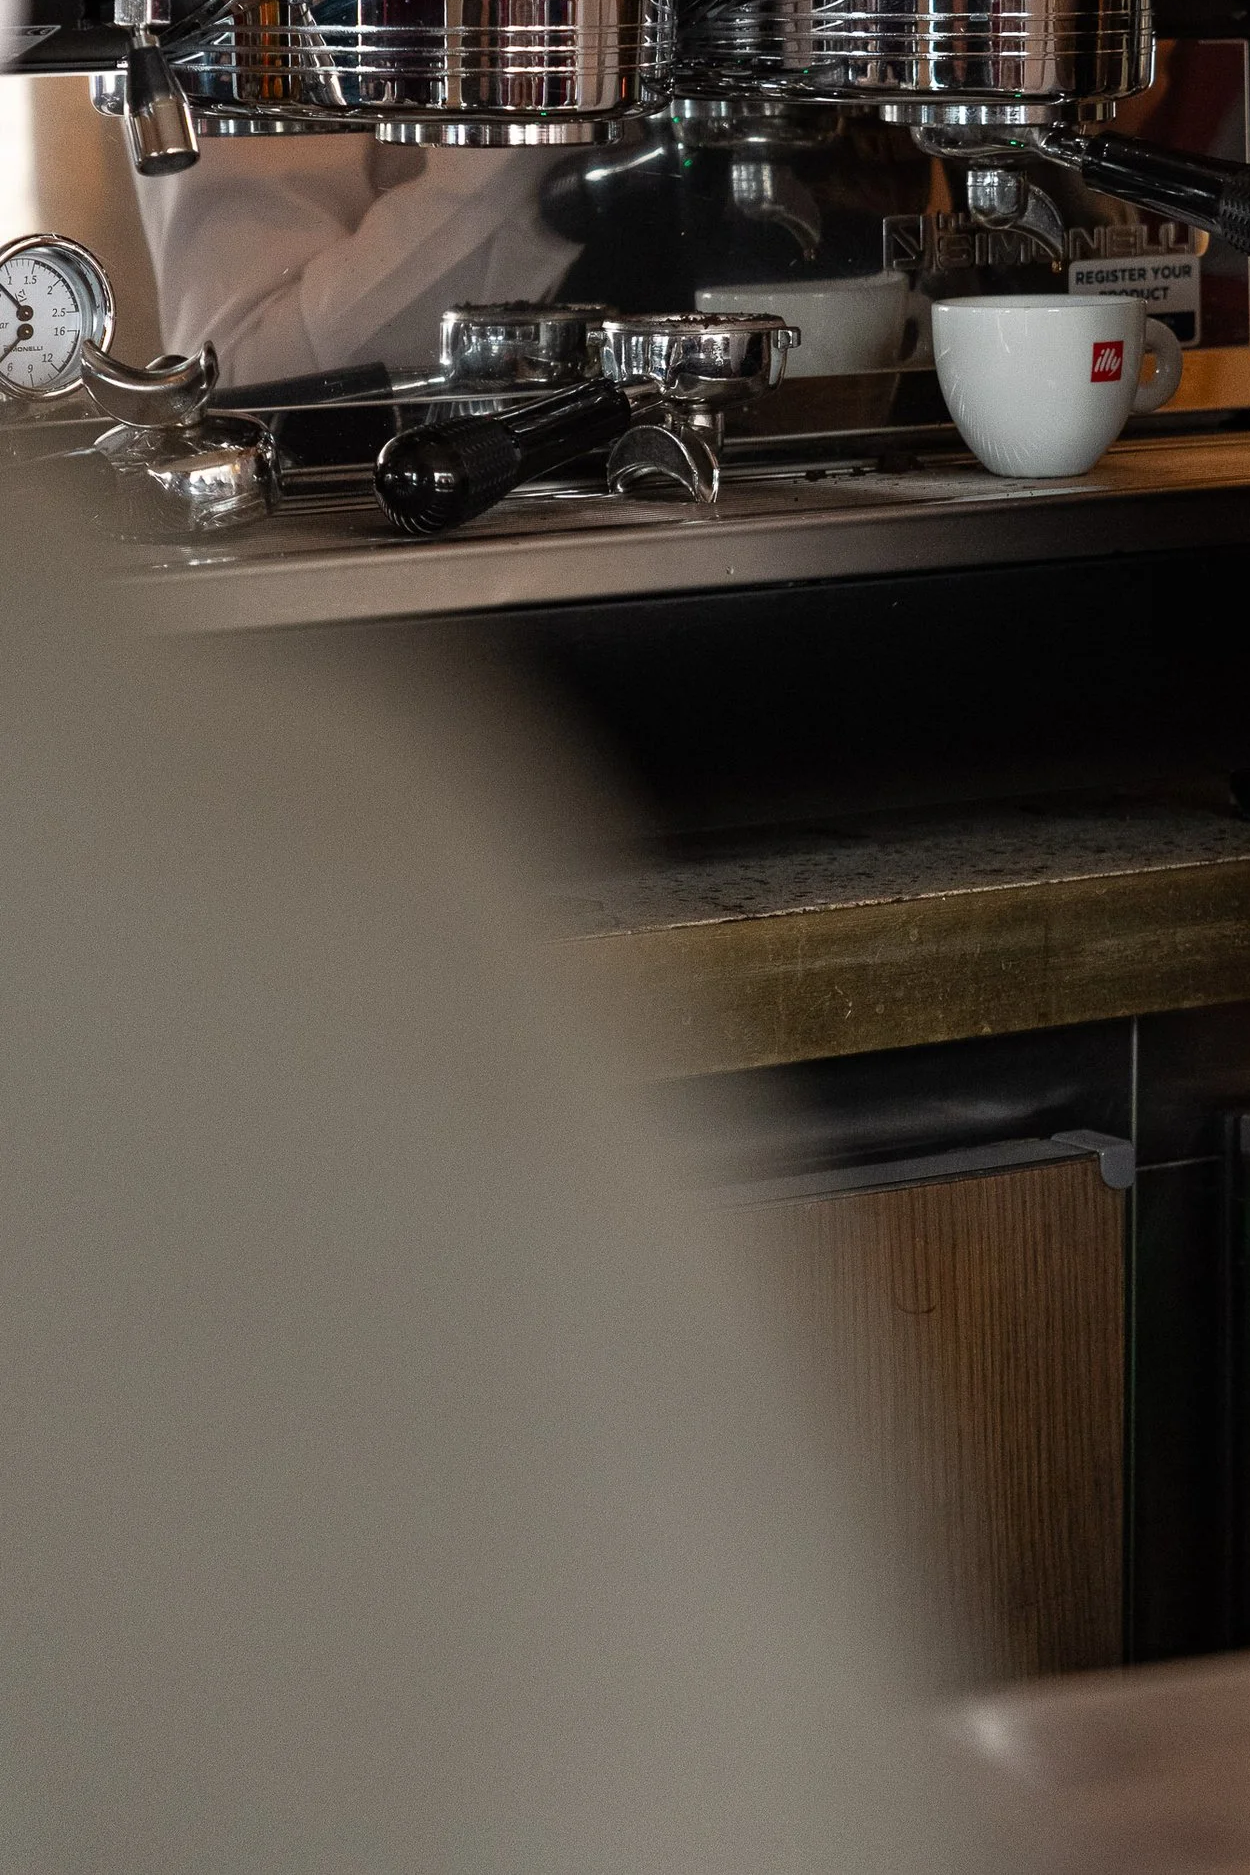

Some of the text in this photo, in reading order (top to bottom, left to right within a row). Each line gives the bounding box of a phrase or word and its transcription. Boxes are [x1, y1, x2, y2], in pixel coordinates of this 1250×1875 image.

[1076, 264, 1193, 285] REGISTER YOUR
[8, 275, 37, 285] 1 1.5
[47, 285, 53, 295] 2
[52, 308, 67, 318] 2.5
[54, 327, 66, 336] 16
[42, 353, 54, 363] 12
[1094, 348, 1121, 376] illy
[7, 362, 34, 374] 6 9
